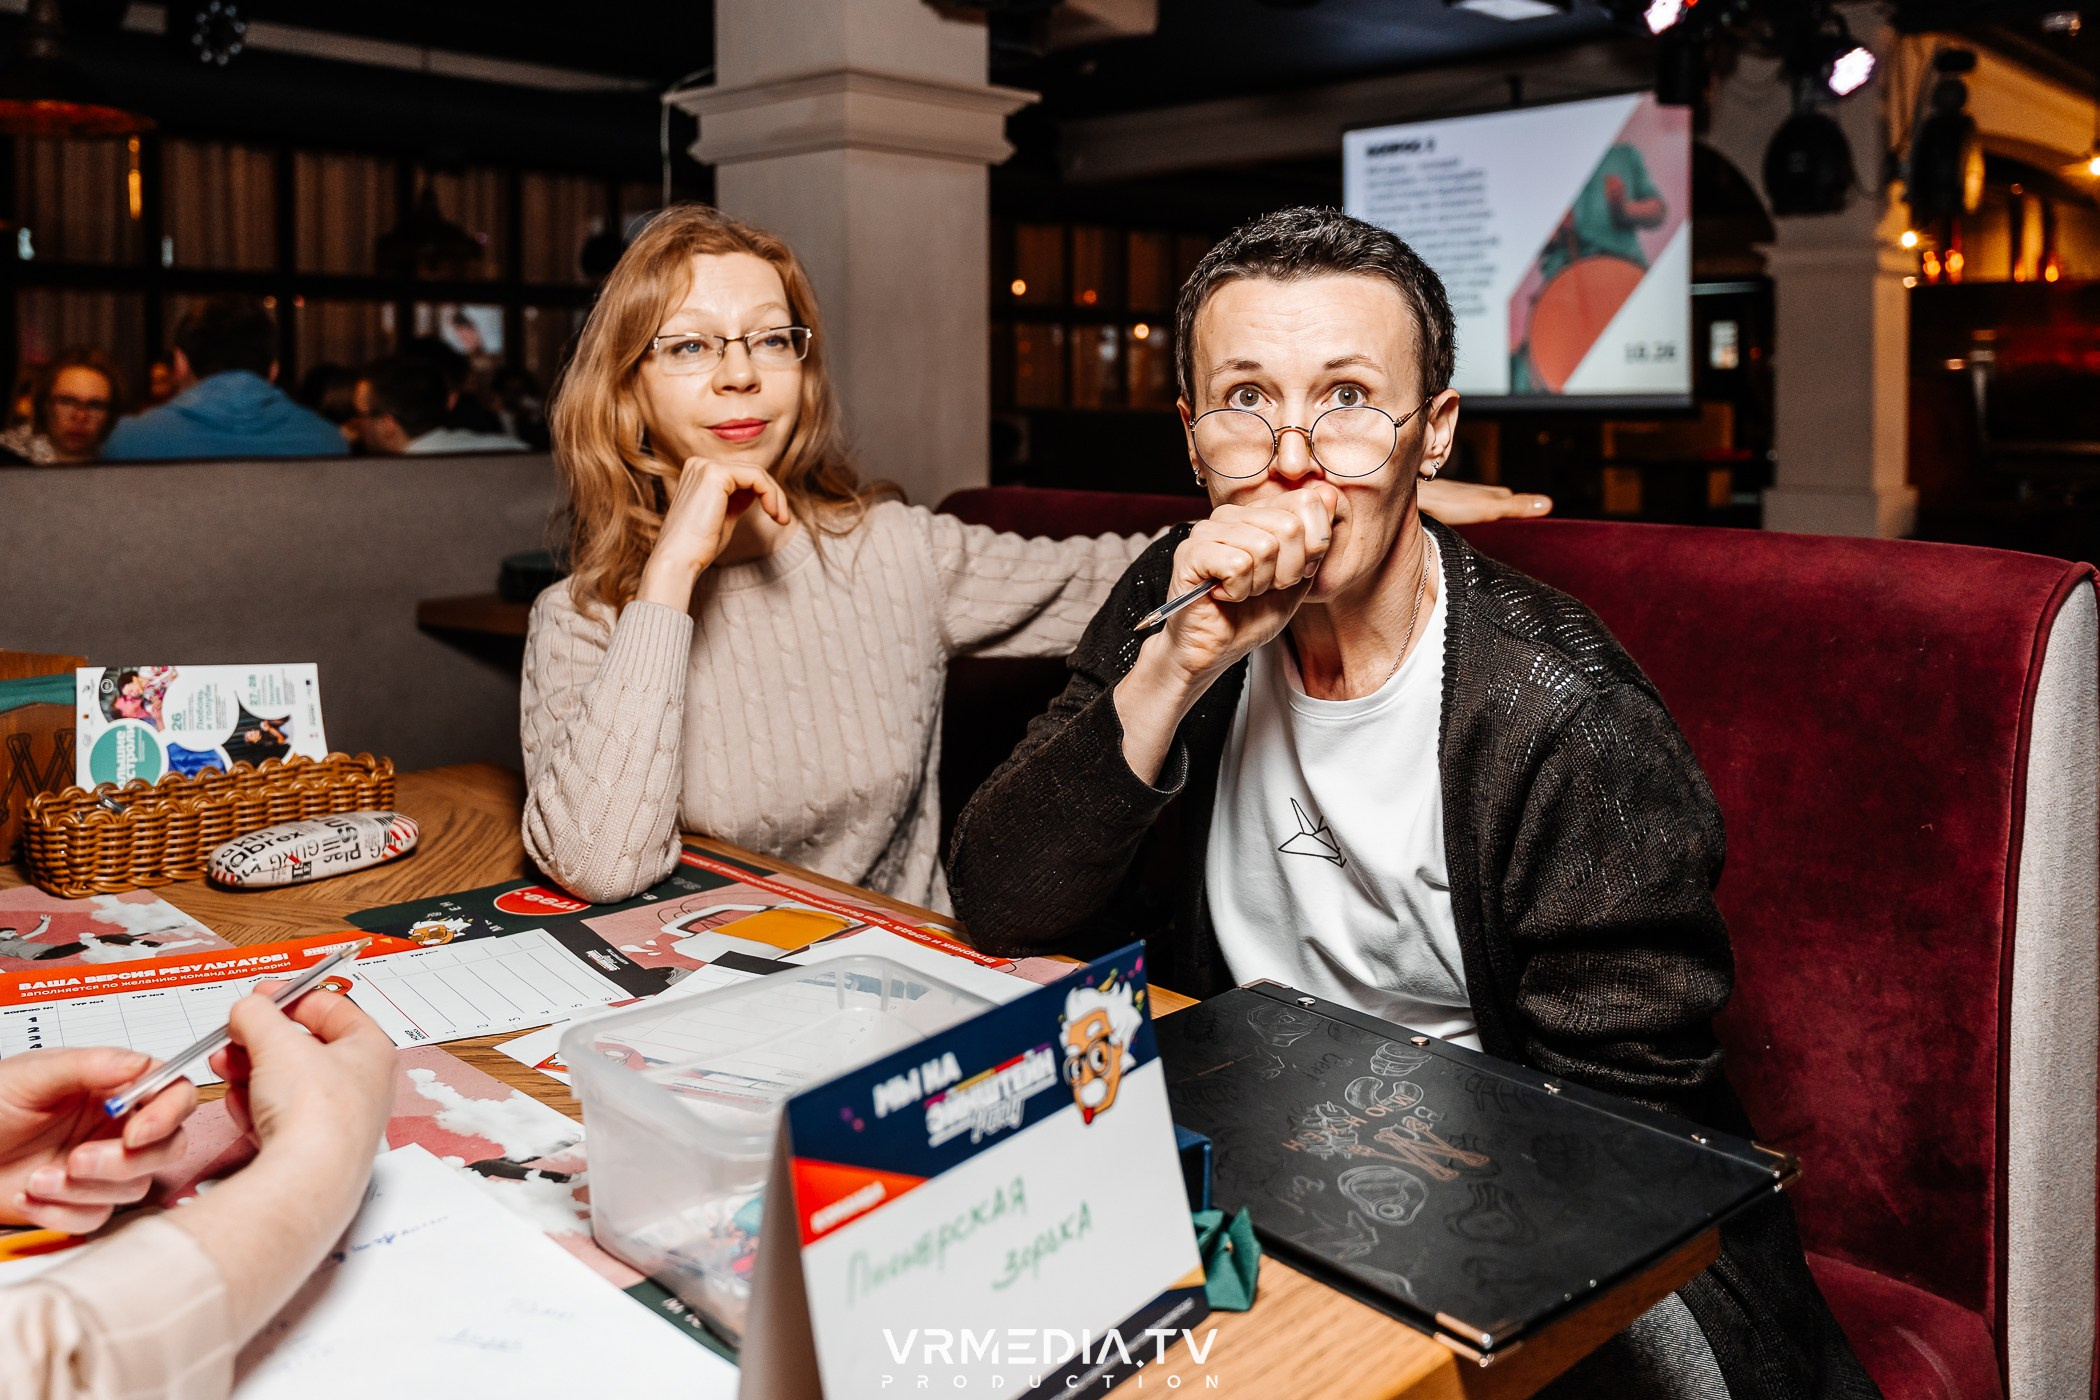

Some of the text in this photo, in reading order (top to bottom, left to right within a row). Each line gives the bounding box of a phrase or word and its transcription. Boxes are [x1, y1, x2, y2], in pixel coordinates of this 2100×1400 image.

[171, 713, 182, 731] 26
[864, 912, 889, 926] дни
[893, 923, 932, 943] среда
[930, 937, 941, 946] и
[942, 940, 998, 966] Вторник
[18, 977, 85, 991] ВАША
[84, 968, 157, 985] ВЕРСИЯ
[20, 961, 292, 998] заполняется по желанию команд для сверки
[27, 1026, 40, 1034] 2
[920, 1050, 963, 1095] НА
